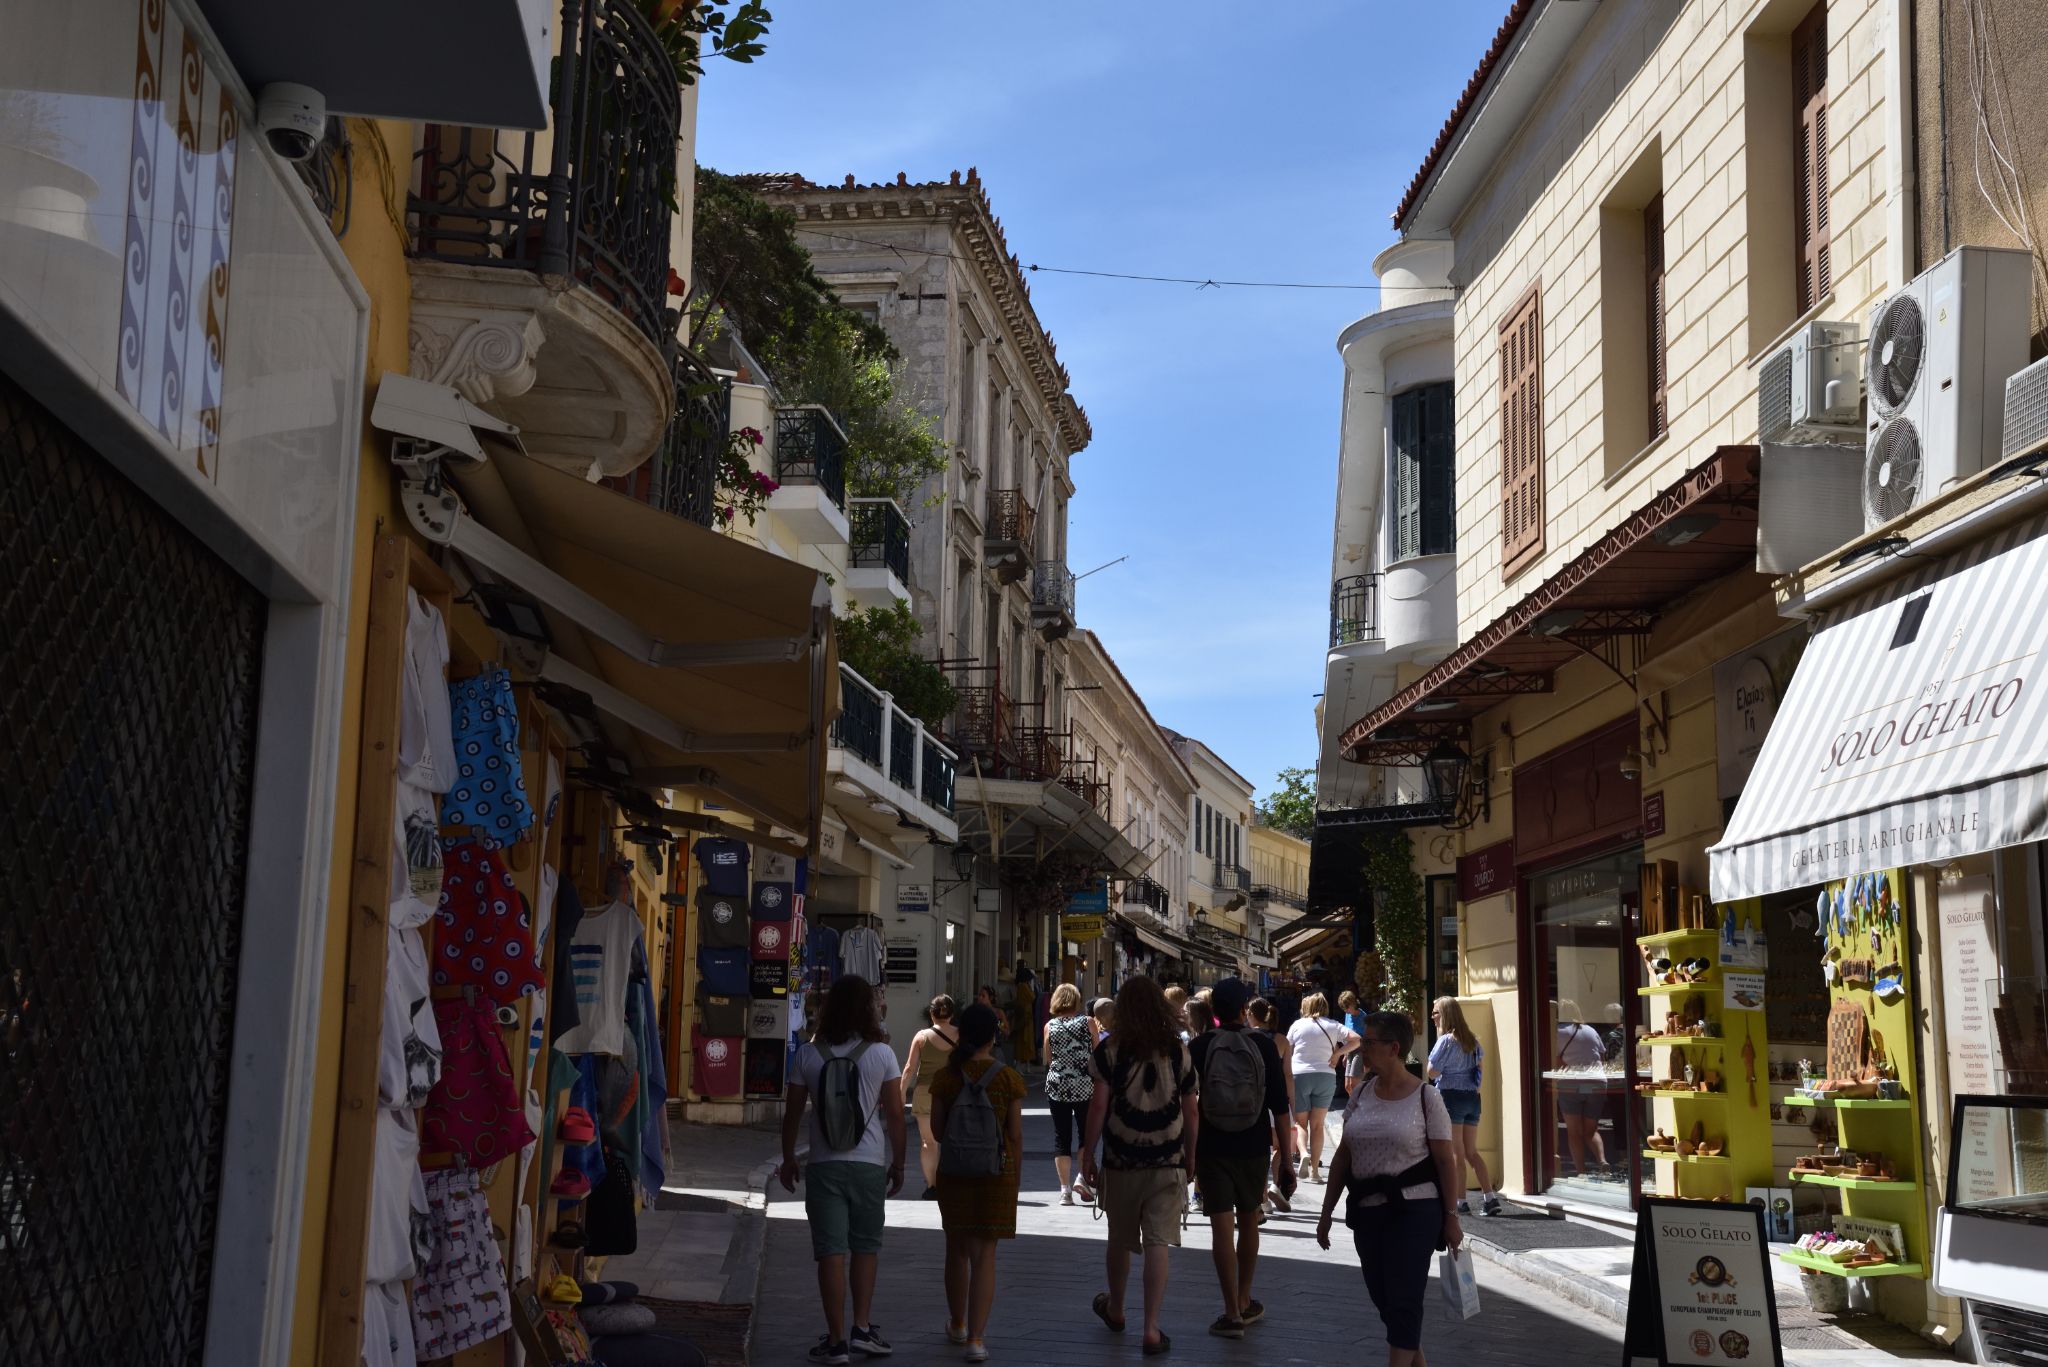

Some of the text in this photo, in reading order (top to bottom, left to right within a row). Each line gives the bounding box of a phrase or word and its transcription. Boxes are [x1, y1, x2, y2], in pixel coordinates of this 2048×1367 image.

[1919, 679, 1945, 700] 1951
[1820, 677, 2024, 773] SOLO GELATO
[1792, 812, 1980, 868] GELATERIA ARTIGIANALE
[1946, 911, 1986, 924] SOLO GELATO
[1662, 1225, 1752, 1242] SOLO GELATO
[1711, 1292, 1738, 1305] PLACE
